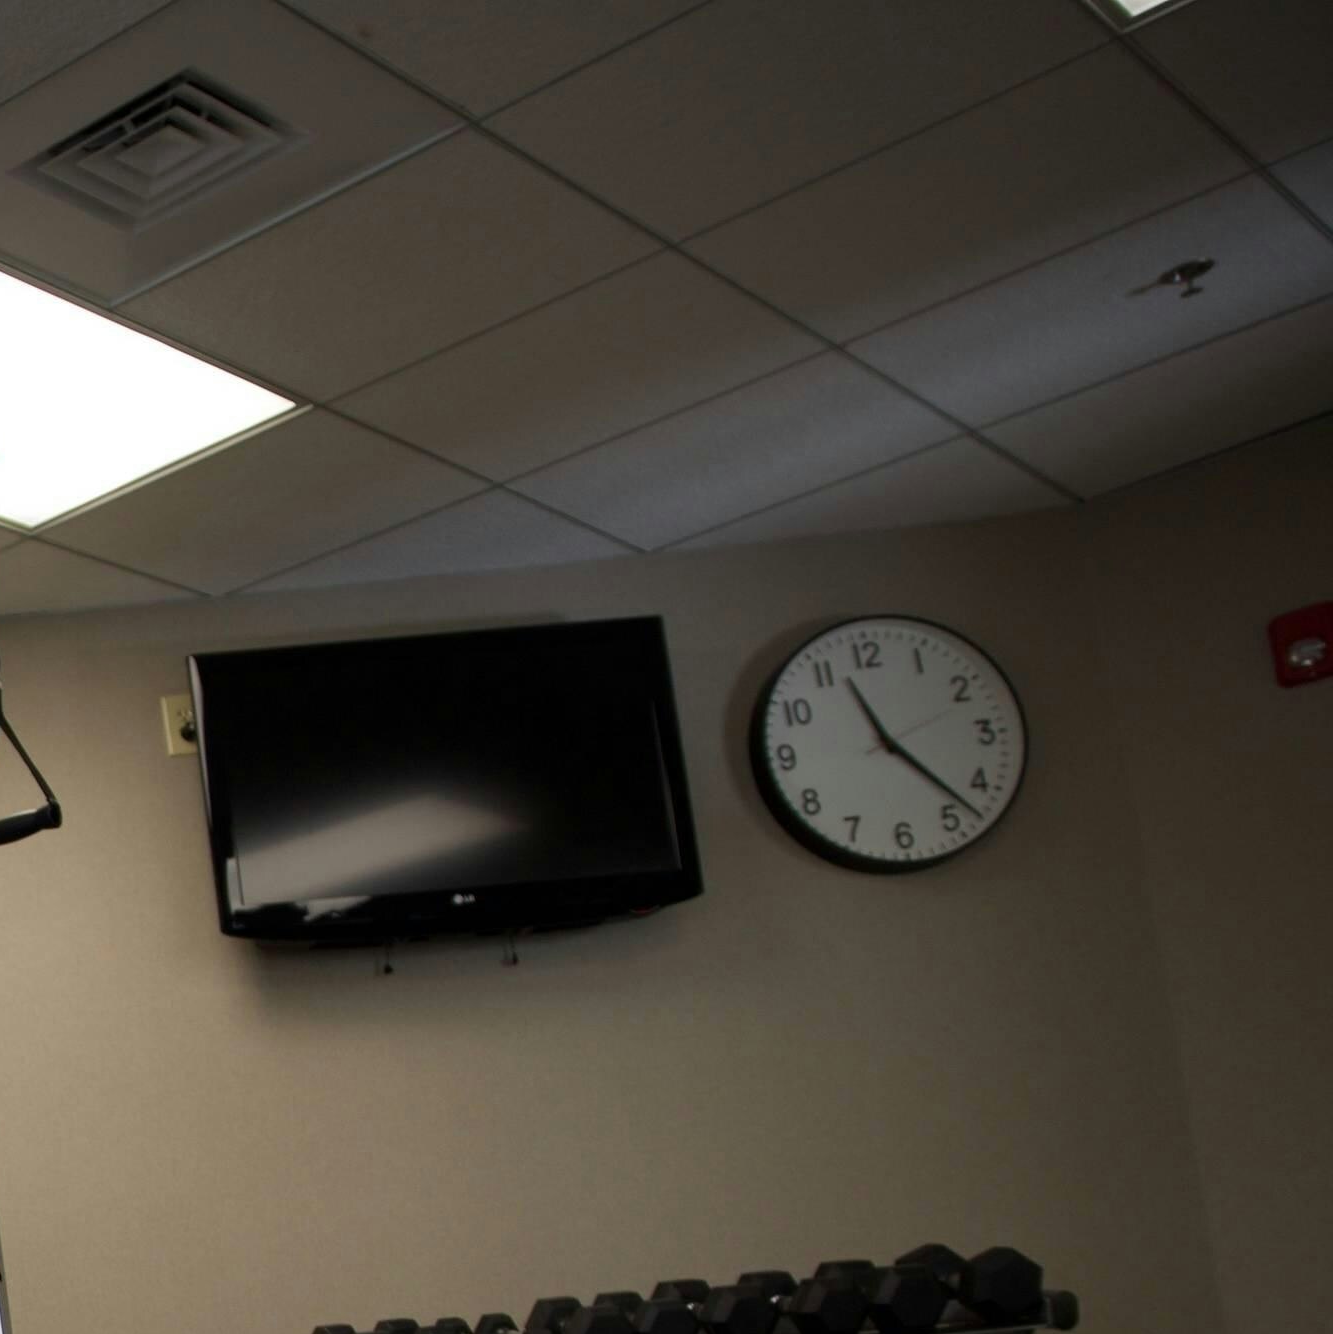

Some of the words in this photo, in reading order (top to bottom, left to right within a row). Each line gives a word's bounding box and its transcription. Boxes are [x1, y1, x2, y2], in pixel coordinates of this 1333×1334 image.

[852, 641, 882, 669] 12
[913, 647, 924, 675] 1
[813, 660, 834, 688] 11
[949, 675, 972, 703] 2
[783, 698, 812, 727] 10
[973, 718, 996, 745] 3
[776, 744, 797, 770] 9
[970, 767, 989, 792] 4
[801, 788, 822, 816] 8
[844, 815, 862, 843] 7
[939, 803, 961, 832] 5
[893, 822, 915, 849] 6
